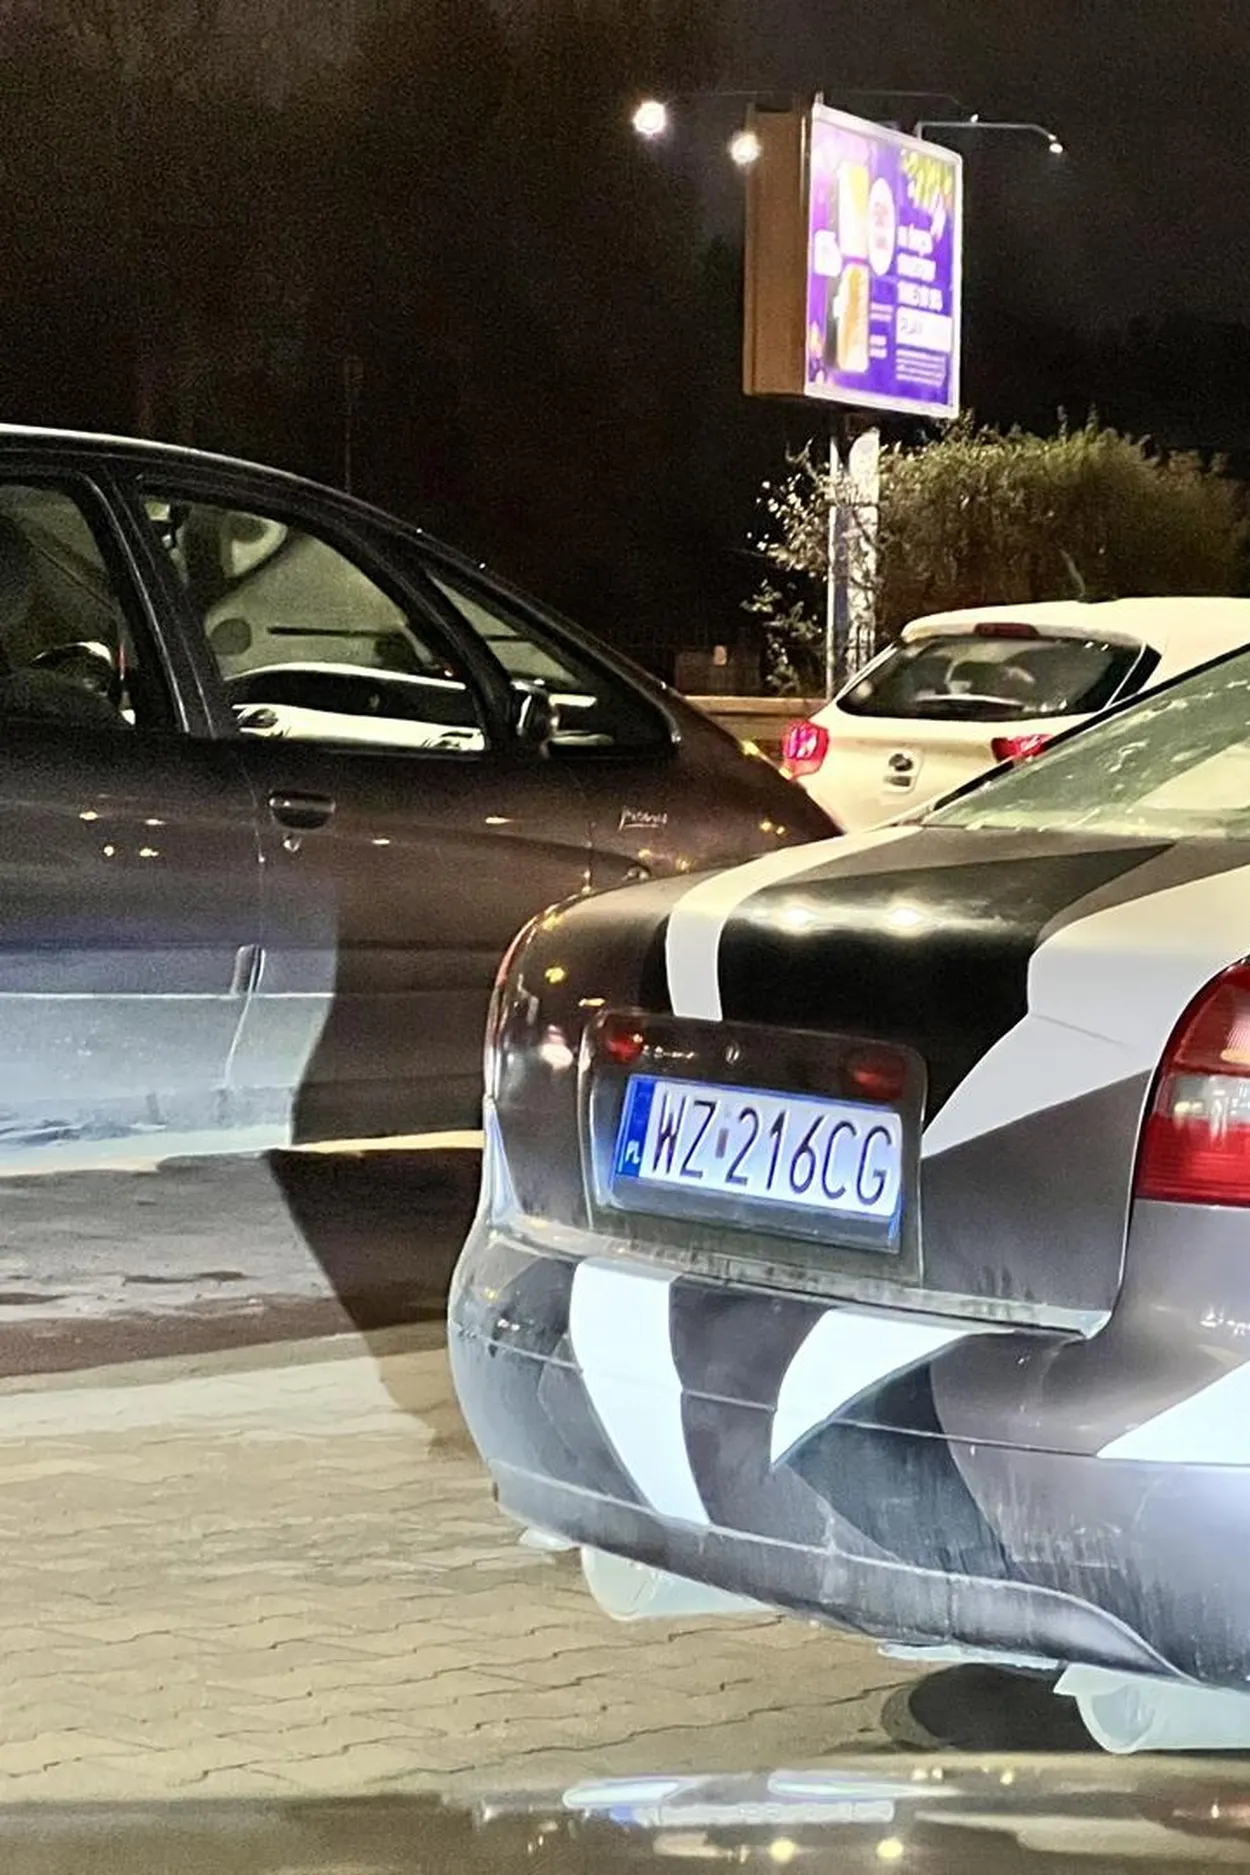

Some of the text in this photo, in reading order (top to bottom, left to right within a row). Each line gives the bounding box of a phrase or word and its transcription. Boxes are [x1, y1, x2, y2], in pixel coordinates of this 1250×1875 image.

[625, 1140, 640, 1164] PL
[651, 1091, 892, 1205] WZ 216CG
